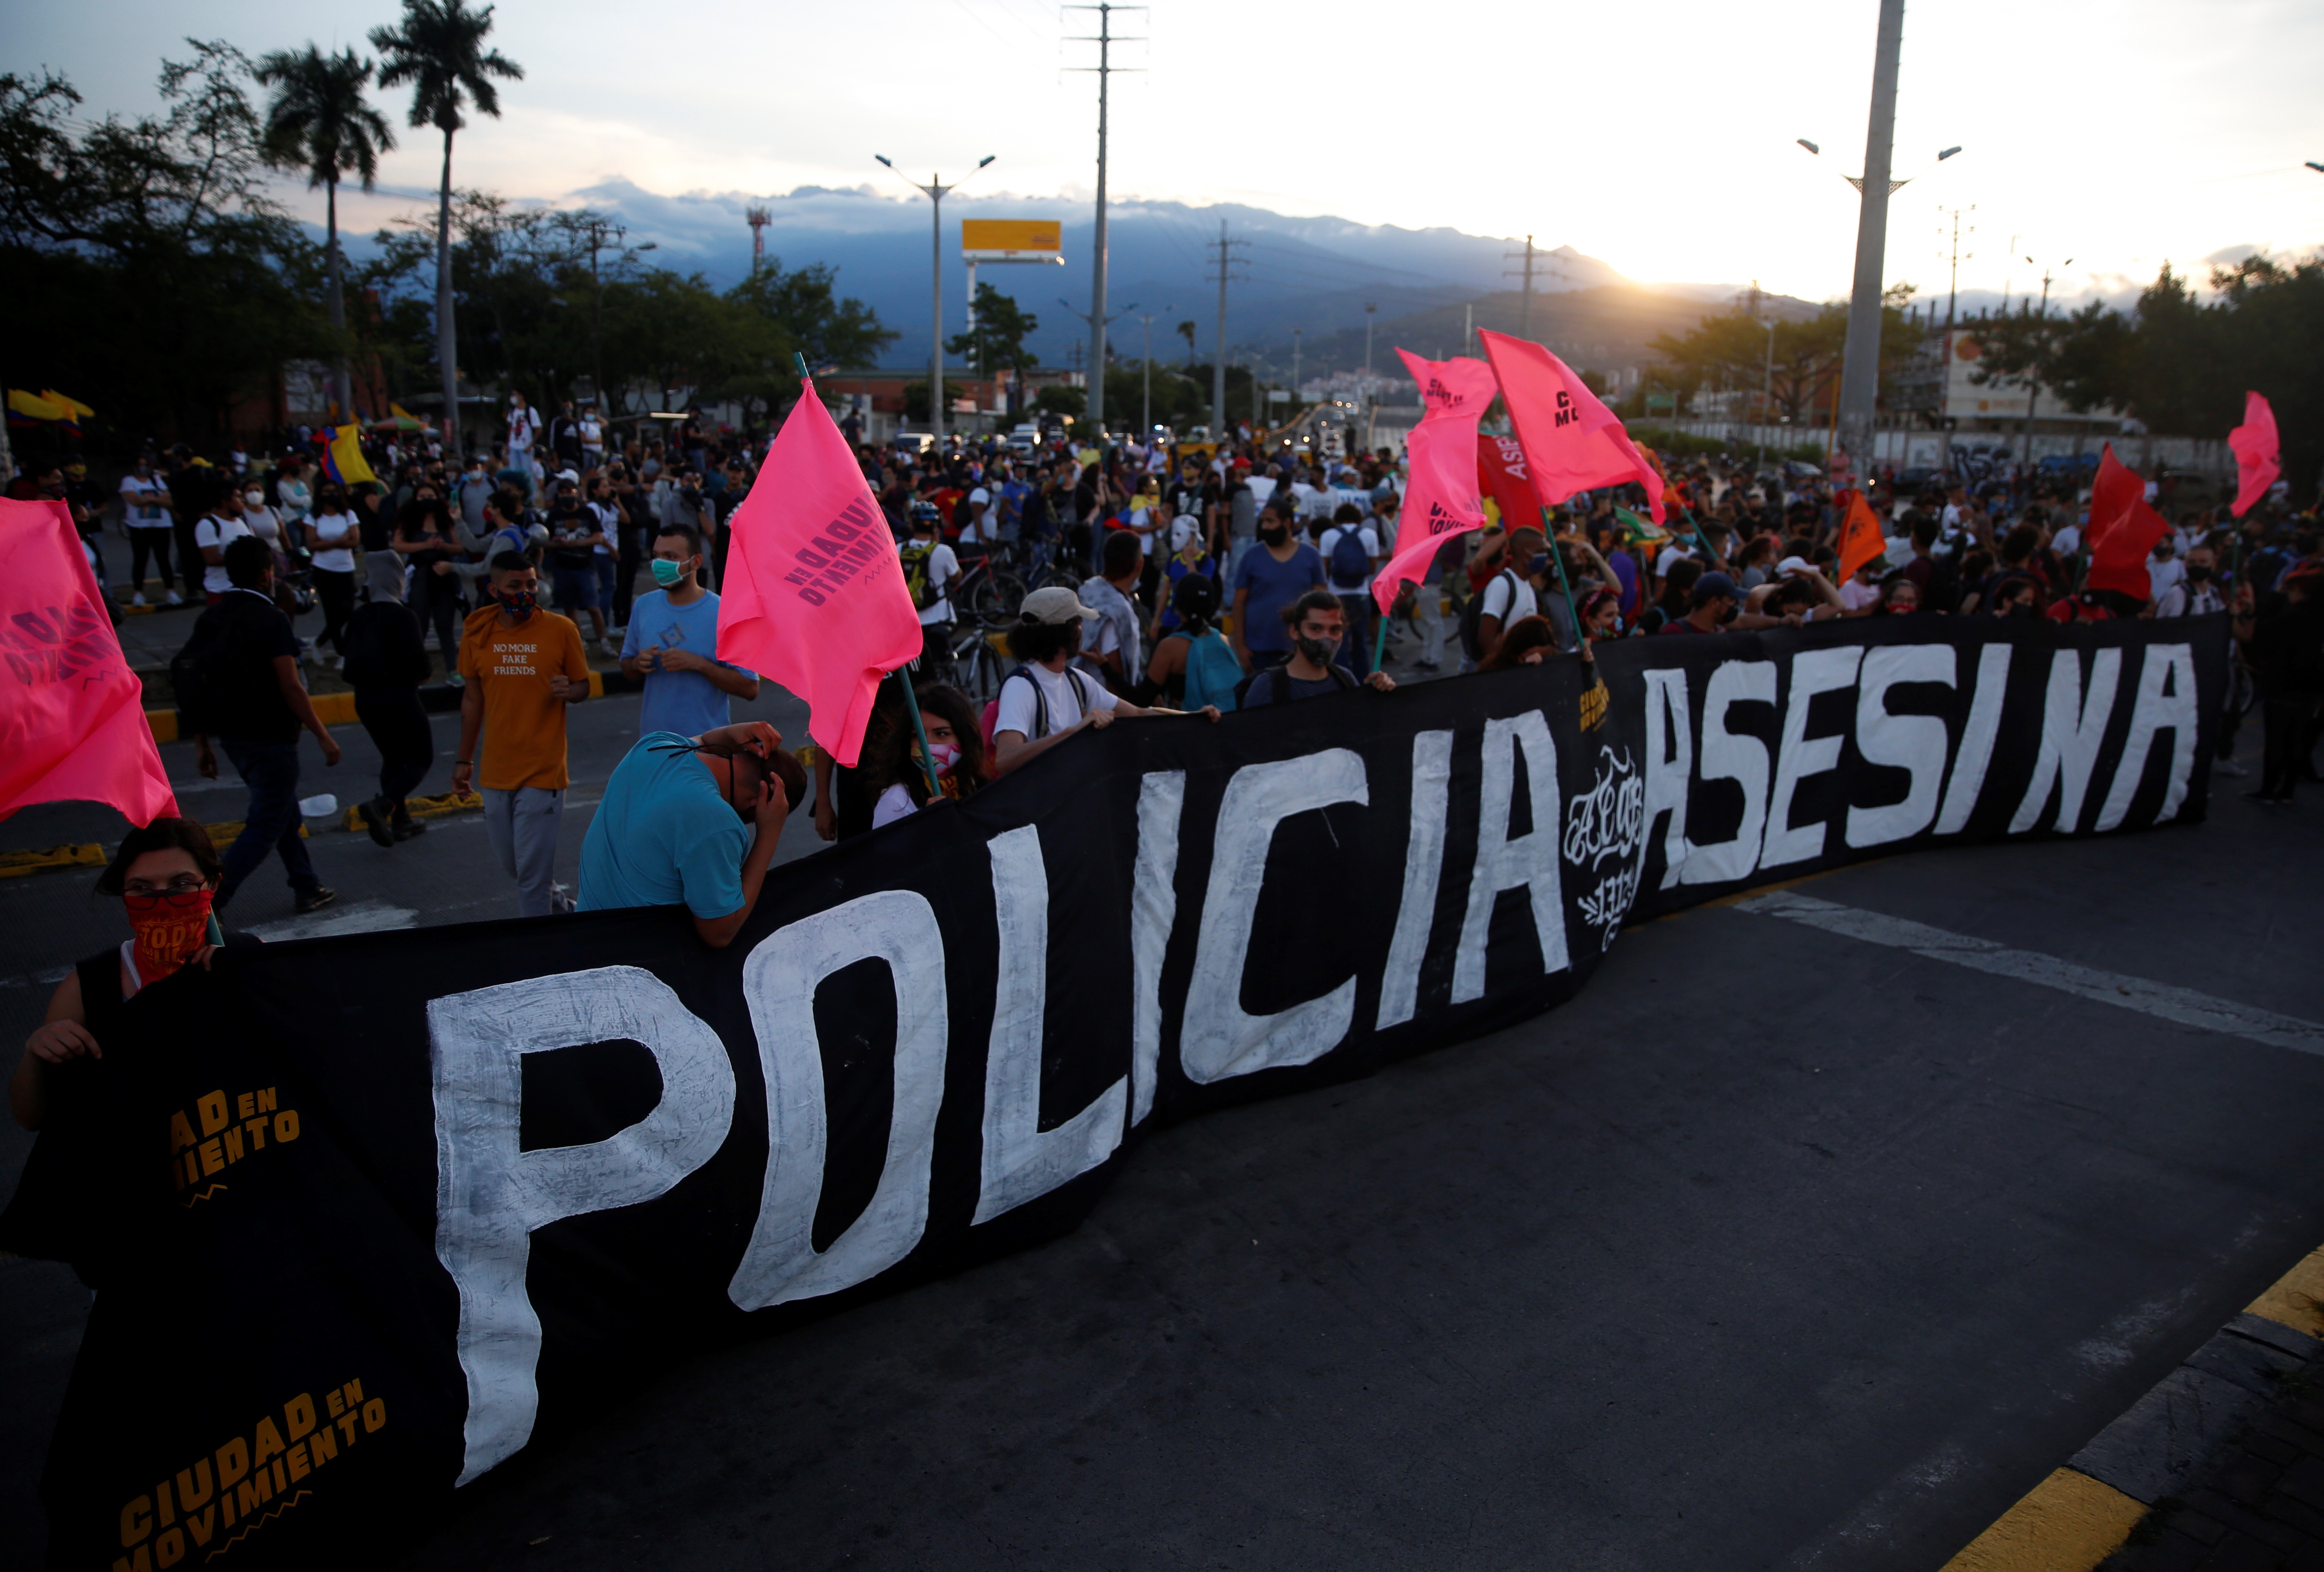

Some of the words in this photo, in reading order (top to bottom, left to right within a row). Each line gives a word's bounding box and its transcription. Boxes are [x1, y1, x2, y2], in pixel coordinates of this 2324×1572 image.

[493, 644, 507, 653] NO
[508, 643, 537, 653] MORE
[494, 666, 536, 675] FRIENDS
[502, 655, 528, 664] FAKE
[427, 709, 1569, 1489] POLICIA
[1627, 642, 2199, 913] ASESINA
[238, 1086, 277, 1120] EN
[119, 1392, 317, 1548] CIUDAD
[325, 1377, 365, 1419] EN
